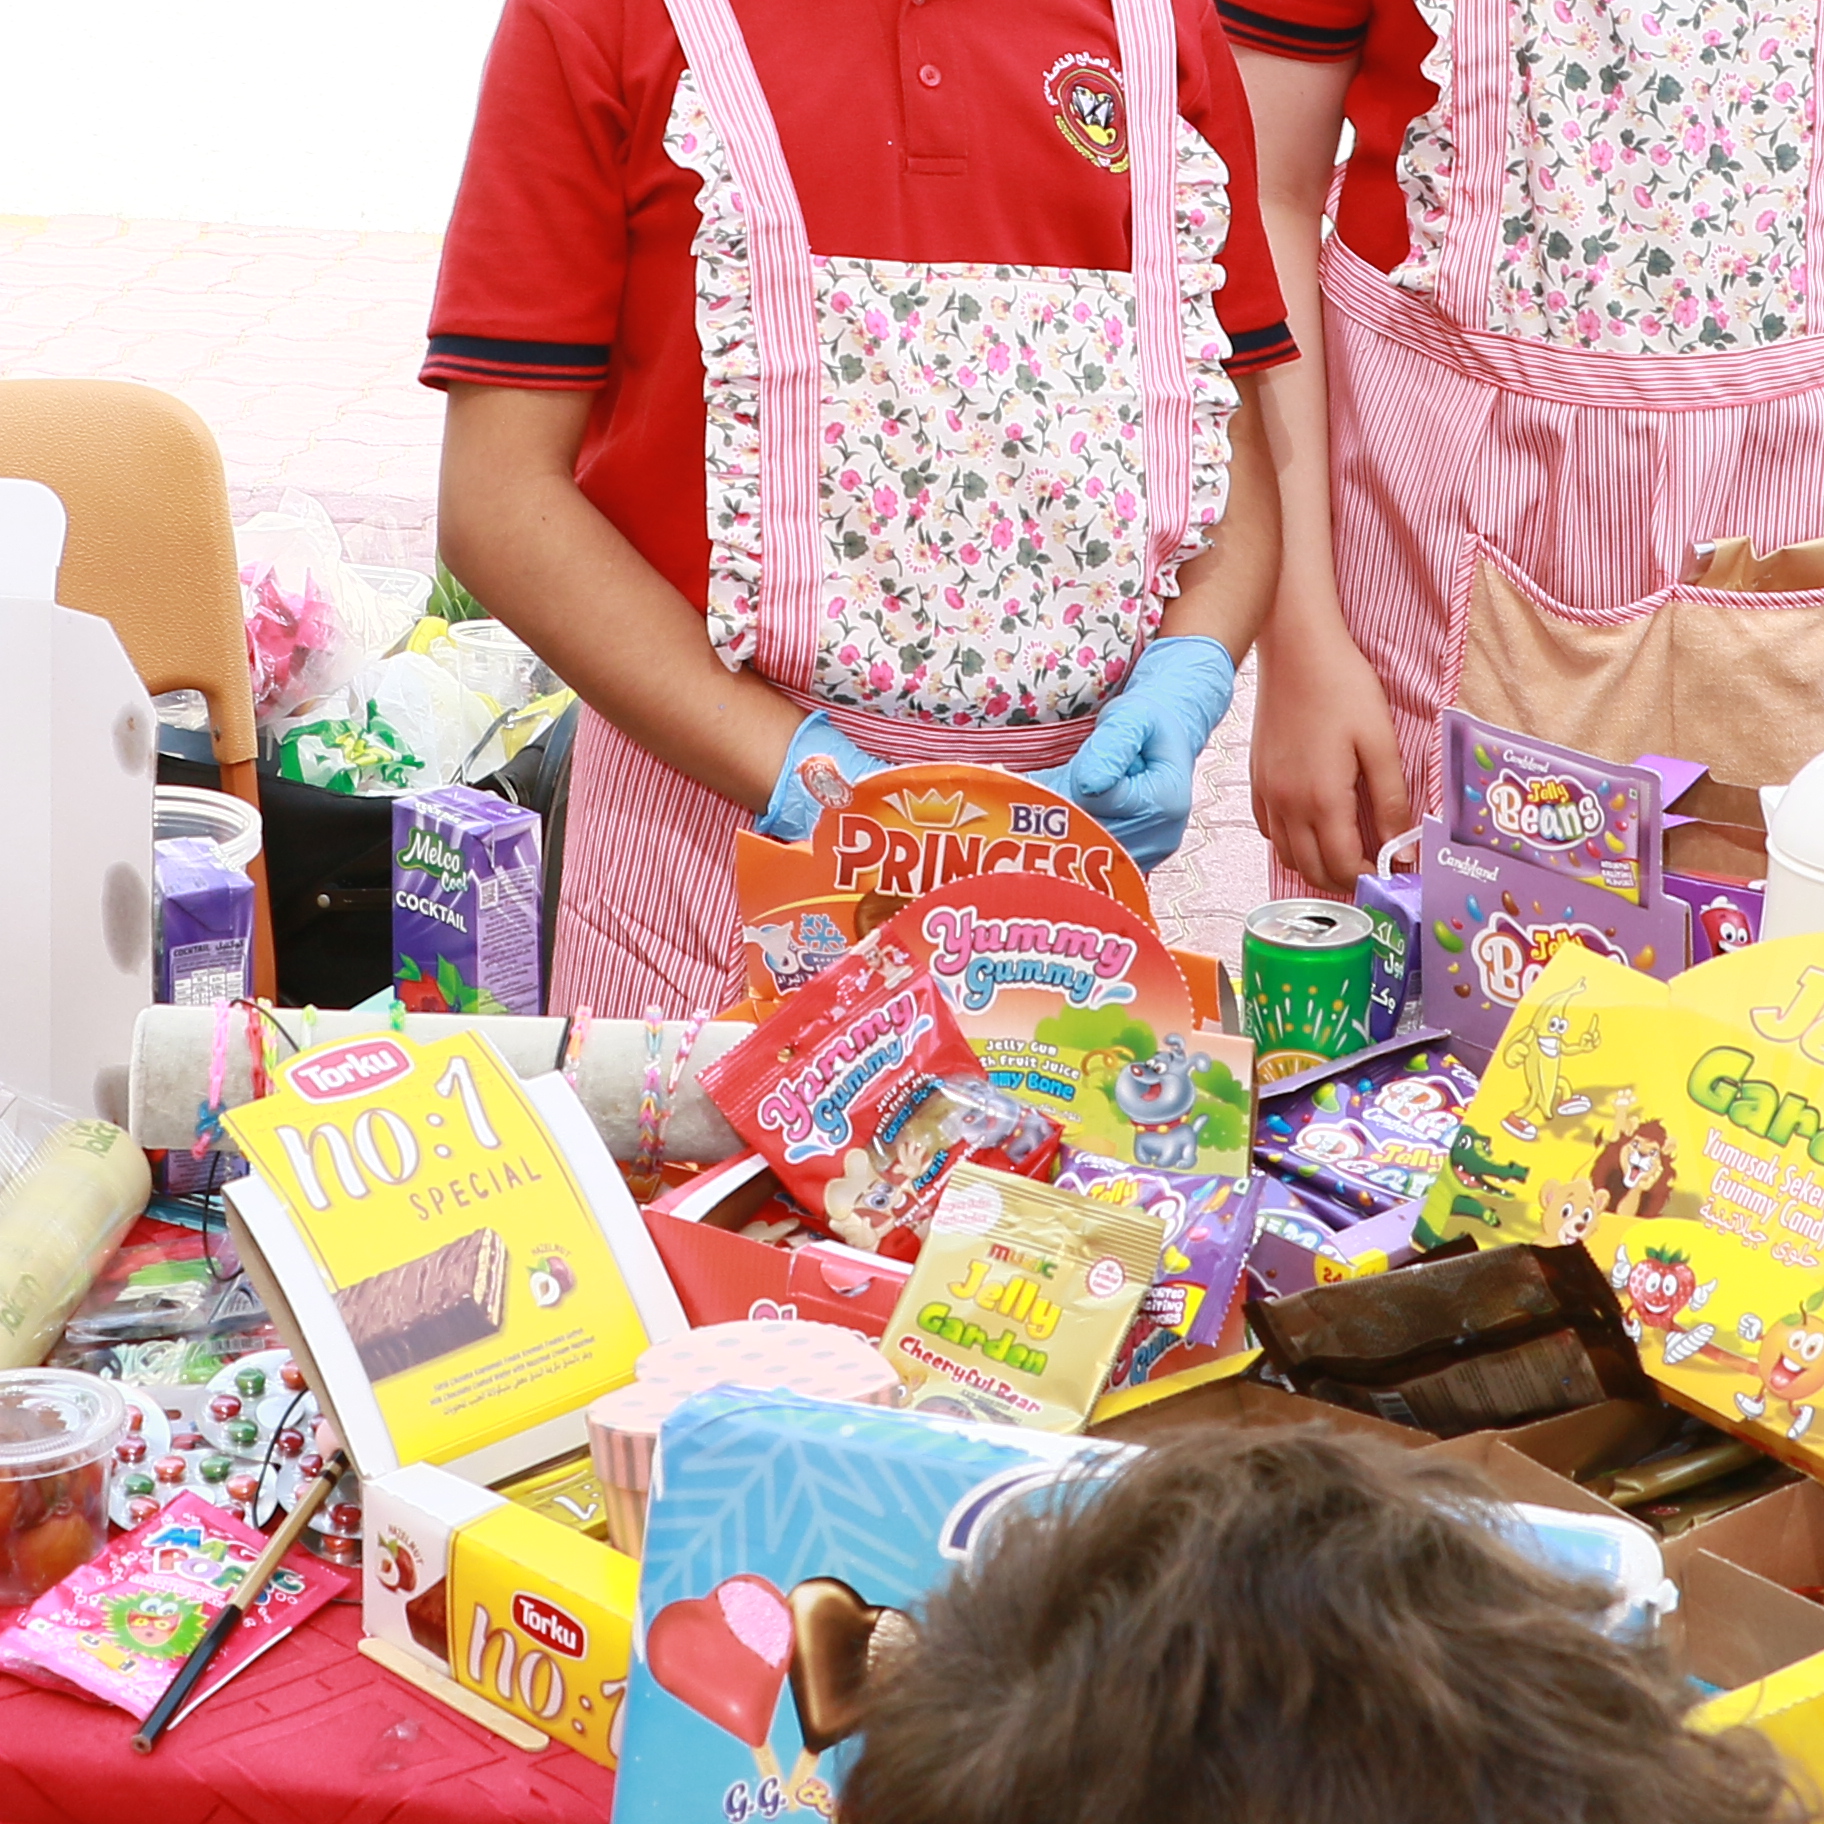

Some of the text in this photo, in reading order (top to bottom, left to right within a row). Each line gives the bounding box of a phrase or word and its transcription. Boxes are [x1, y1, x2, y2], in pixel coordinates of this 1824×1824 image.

[1503, 748, 1550, 774] Candyland
[1491, 780, 1604, 841] Beans
[1526, 779, 1571, 804] Jelly
[402, 831, 462, 871] Melco
[833, 813, 1114, 898] PRINCESS
[1437, 846, 1501, 884] Candyland
[440, 871, 469, 893] Cool
[395, 889, 469, 934] COCKTAIL
[923, 907, 1136, 979] Yummy
[964, 956, 1095, 1010] Gummy
[298, 1046, 399, 1093] Torku
[761, 994, 915, 1142] Yummy
[986, 1040, 1058, 1056] Jelly Gum
[1042, 1060, 1081, 1080] Juice
[813, 1036, 905, 1144] Gummy
[988, 1071, 1076, 1101] mmy Bone
[1296, 1127, 1437, 1197] Bean
[1371, 1144, 1445, 1173] Jelly
[1697, 1125, 1784, 1189] Yumuşak
[408, 1155, 543, 1222] SPECIAL
[1706, 1165, 1783, 1225] Gummy
[530, 1242, 573, 1258] HAZELNUT
[1769, 1232, 1823, 1276] حلوى
[948, 1258, 1063, 1342] Jelly
[916, 1301, 1049, 1377] Garden
[994, 1381, 1042, 1413] Bear
[386, 1523, 425, 1566] HAZELNUT
[519, 1598, 577, 1651] Torku
